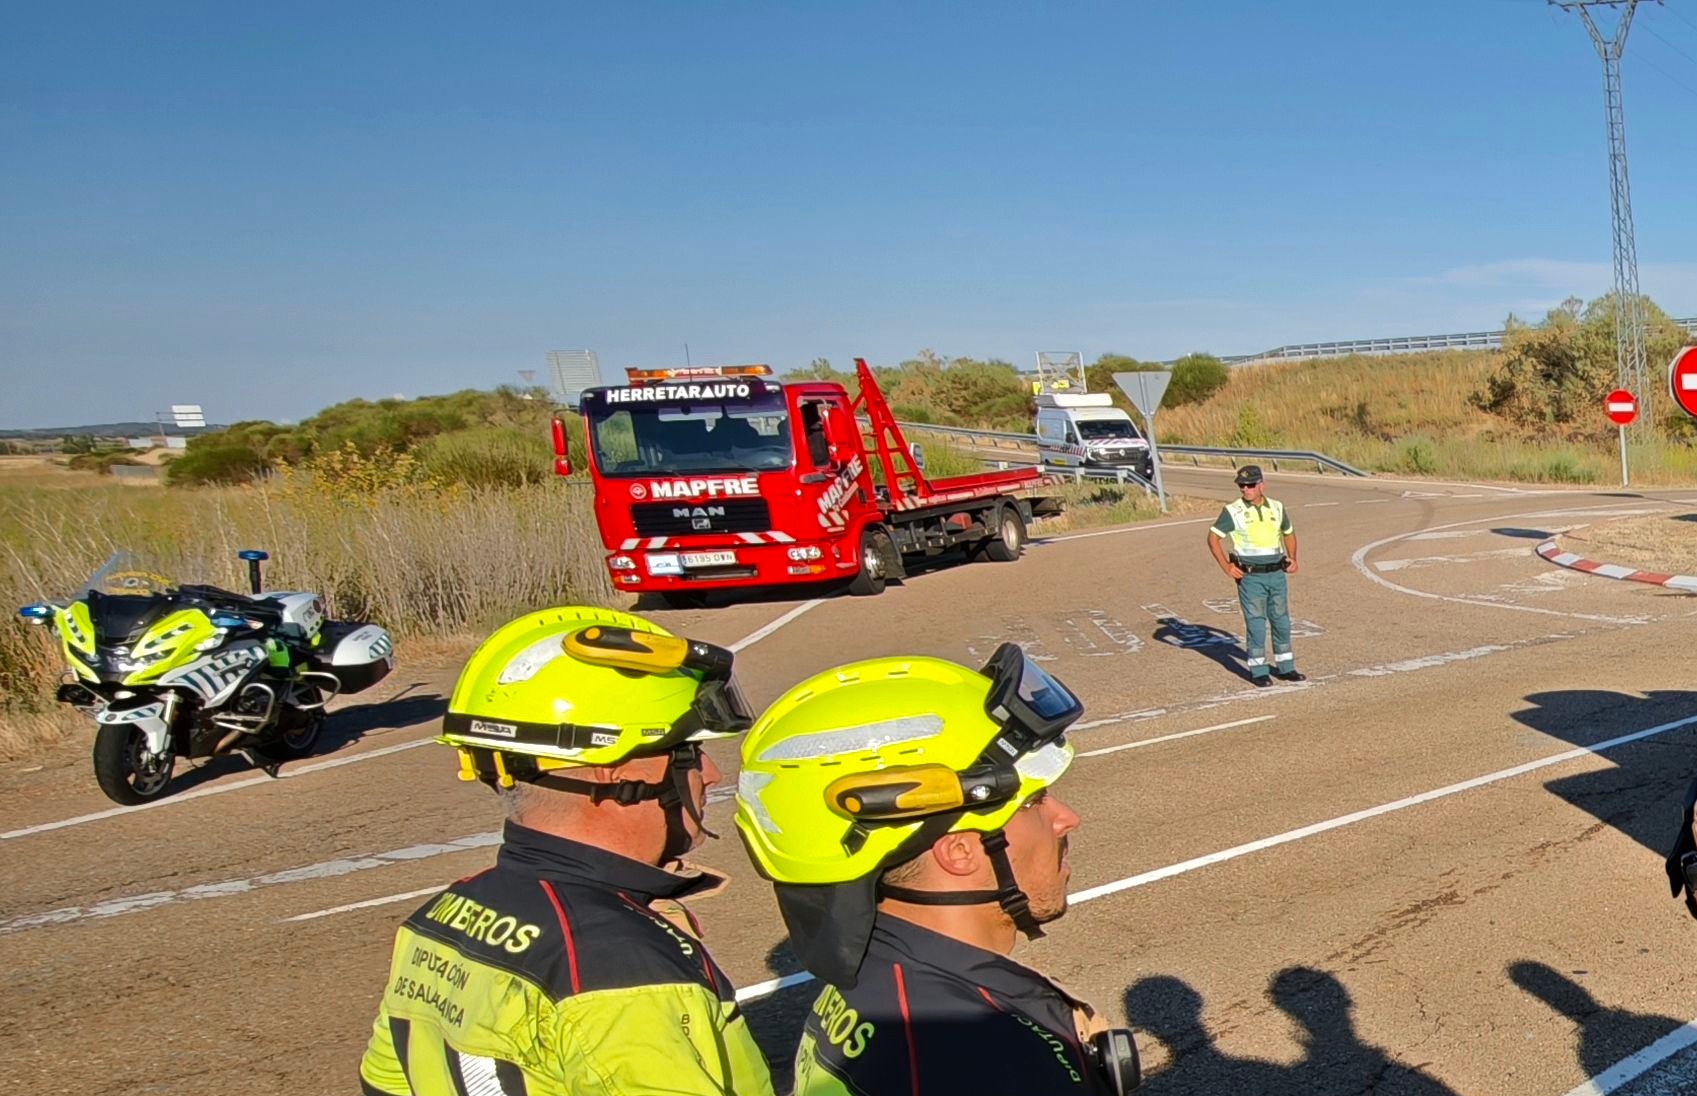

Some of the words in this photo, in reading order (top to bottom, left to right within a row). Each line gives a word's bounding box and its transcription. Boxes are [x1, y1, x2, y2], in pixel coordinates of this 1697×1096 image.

[650, 477, 759, 498] MAPFRE
[672, 506, 725, 518] MAN
[473, 722, 513, 736] MSA
[594, 734, 616, 744] MS
